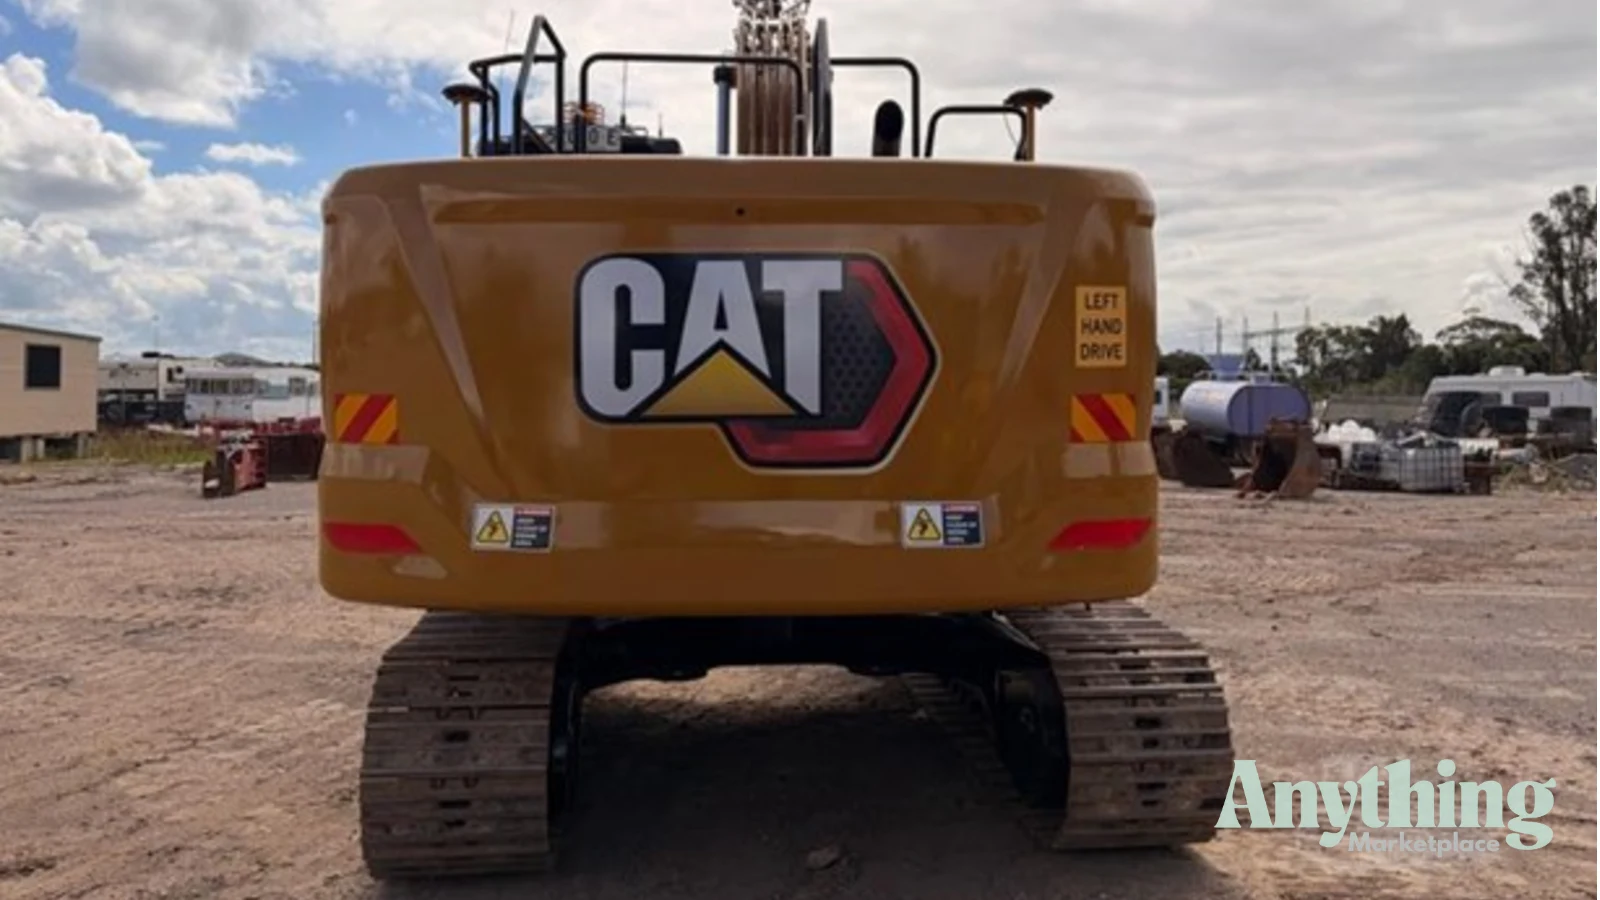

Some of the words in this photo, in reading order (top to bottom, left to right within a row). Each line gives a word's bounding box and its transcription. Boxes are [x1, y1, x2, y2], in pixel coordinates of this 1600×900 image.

[1083, 292, 1119, 310] LEFT
[1080, 317, 1123, 335] HAND
[580, 256, 843, 417] CAT
[1080, 342, 1123, 361] DRIVE
